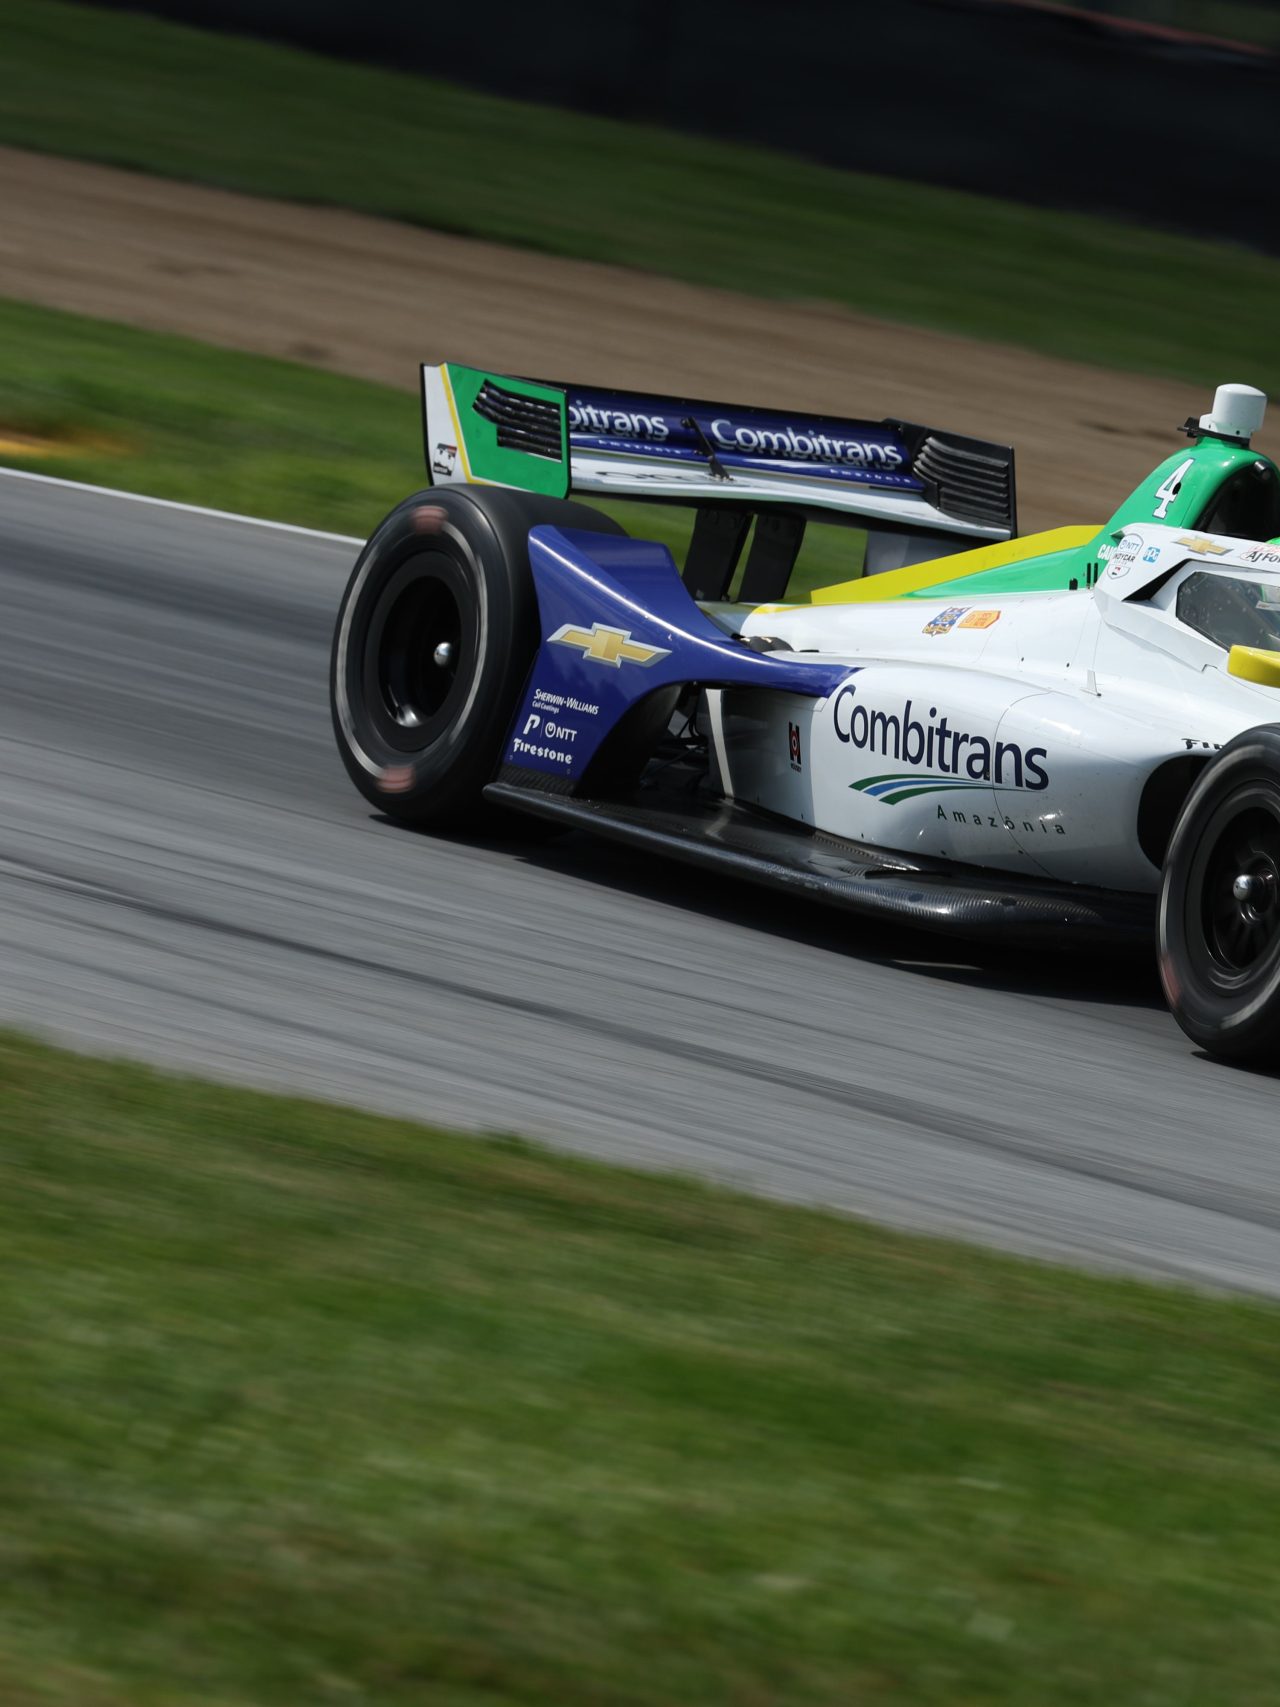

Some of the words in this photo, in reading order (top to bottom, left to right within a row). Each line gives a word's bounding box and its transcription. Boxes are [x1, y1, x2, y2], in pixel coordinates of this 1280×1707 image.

[711, 419, 902, 464] Combitrans
[1152, 457, 1196, 520] 4
[1246, 550, 1261, 562] AJ
[533, 688, 599, 715] SHERWIN-WILLIAMS
[556, 726, 577, 742] NTT
[834, 684, 1049, 790] Combitrans
[513, 738, 572, 764] Firestone
[937, 804, 1066, 836] Amazônia
